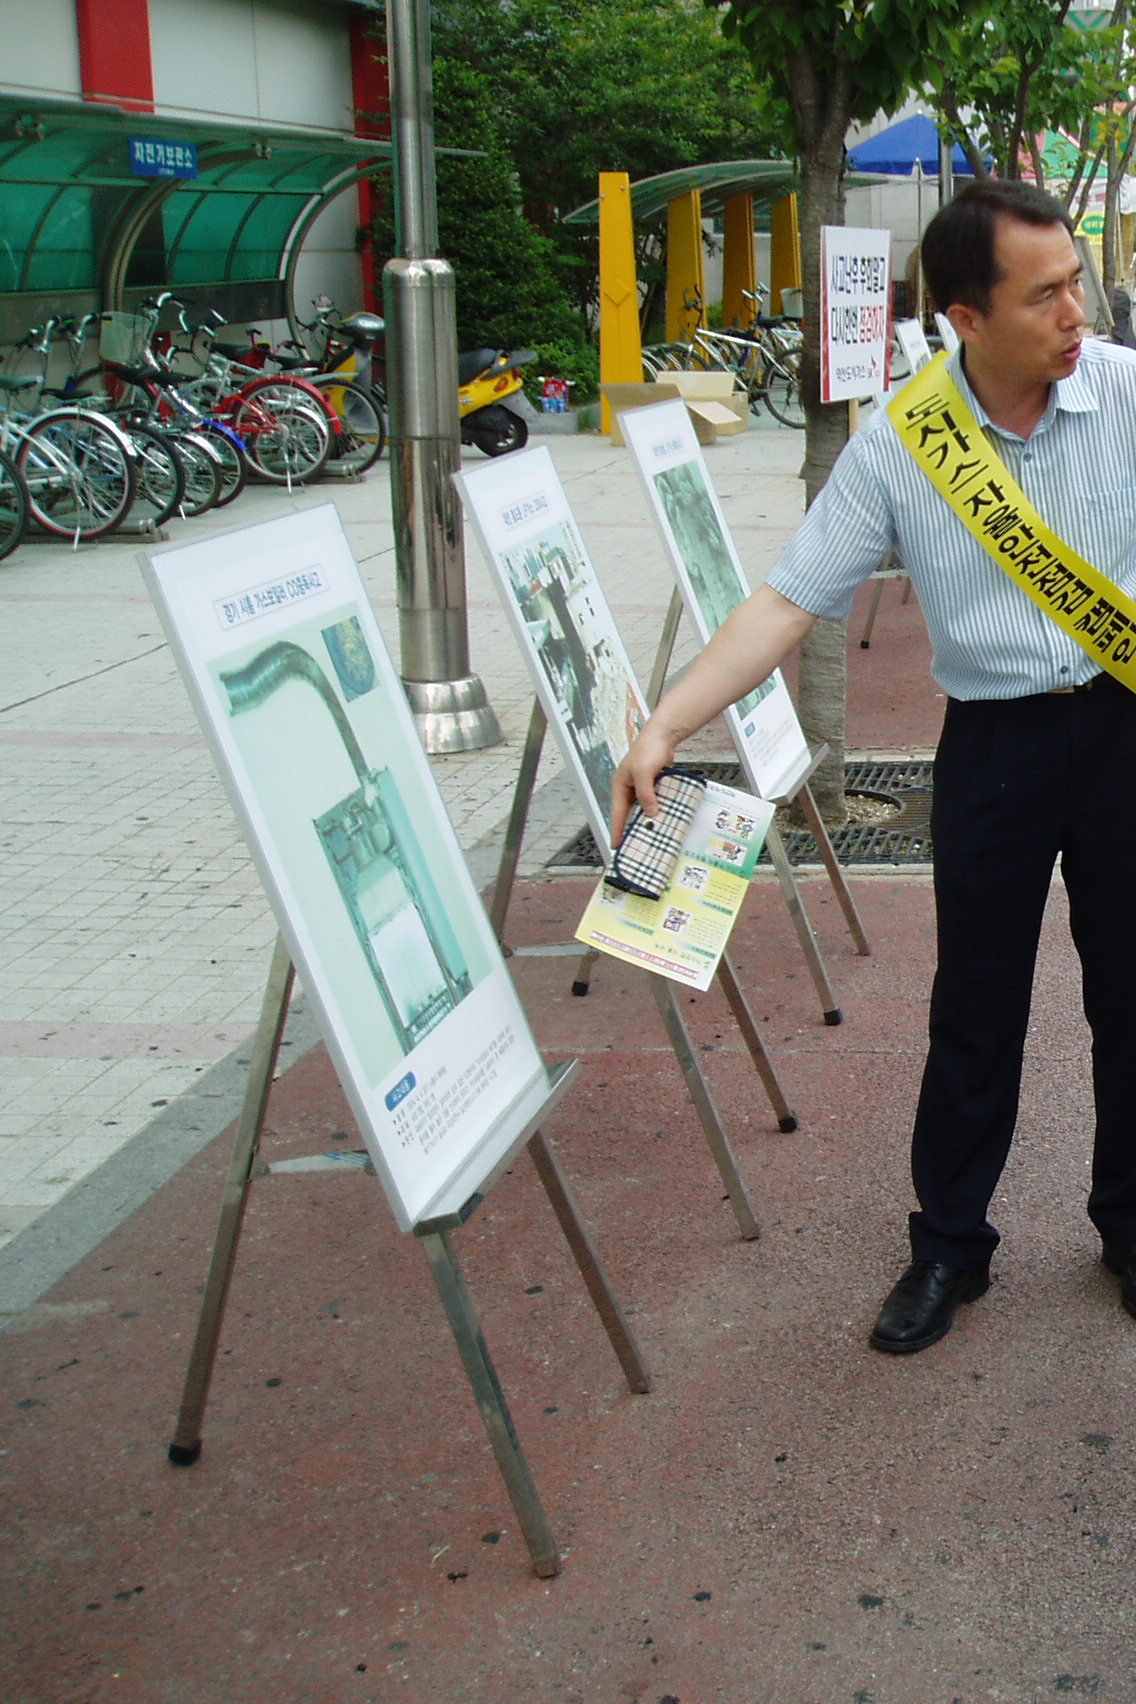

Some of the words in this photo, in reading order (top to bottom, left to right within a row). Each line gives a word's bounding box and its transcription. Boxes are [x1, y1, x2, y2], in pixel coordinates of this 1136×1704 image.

[134, 142, 193, 168] 자전거보관소
[831, 305, 858, 346] 다시한번
[860, 305, 885, 343] 점검하자
[905, 393, 989, 495] 도시가스
